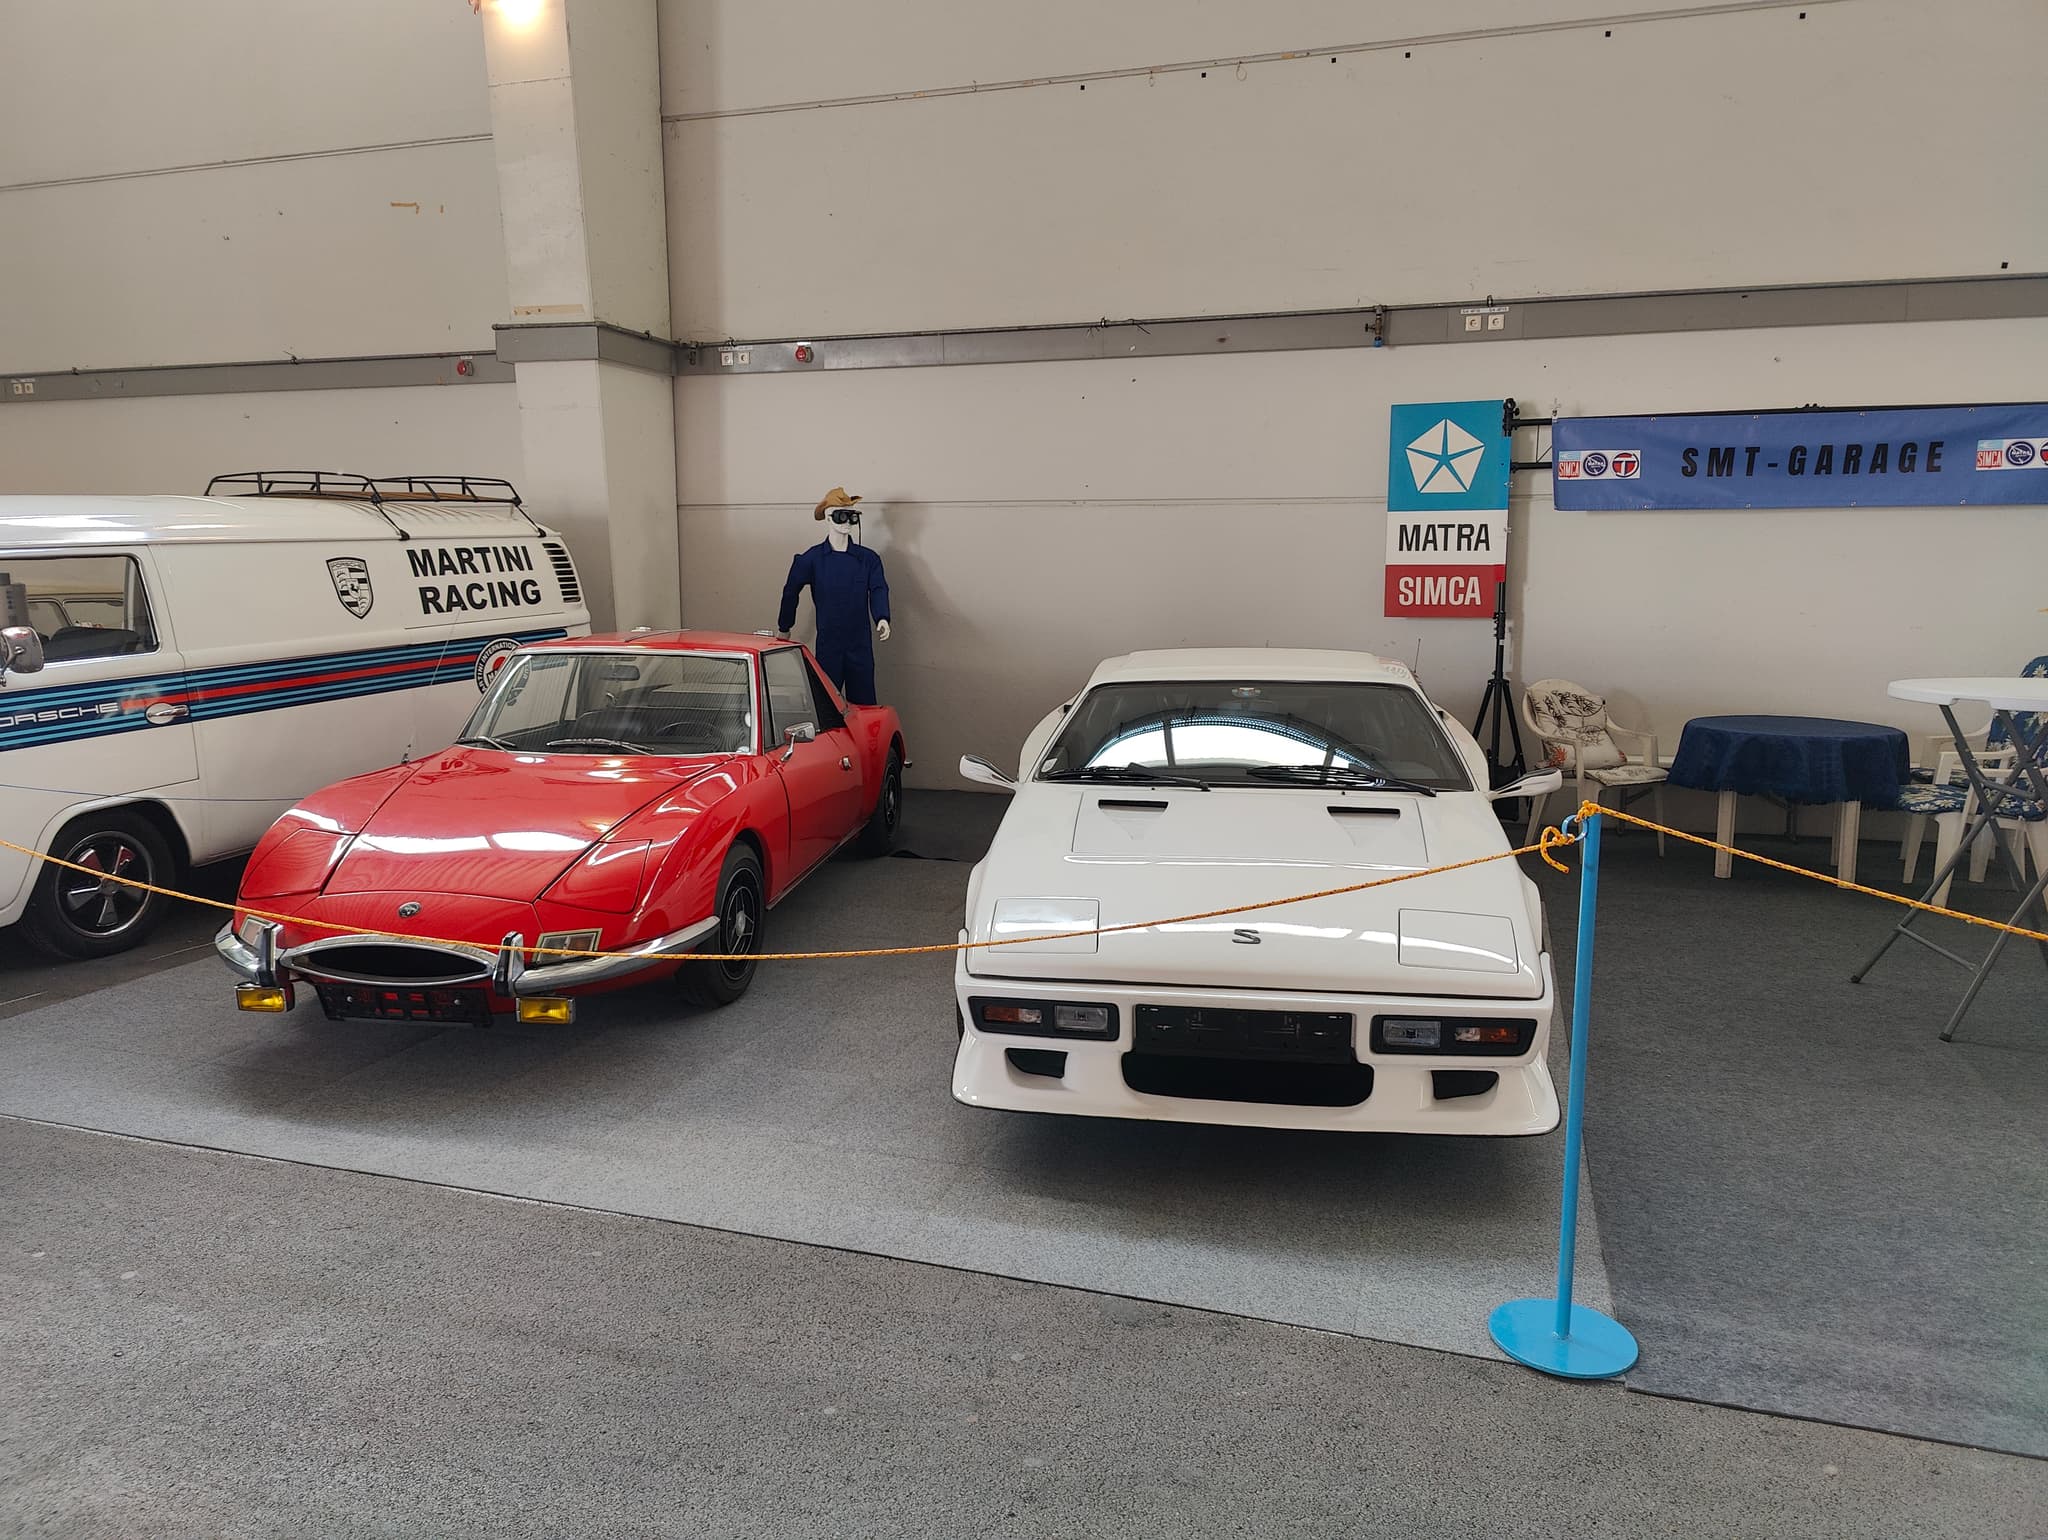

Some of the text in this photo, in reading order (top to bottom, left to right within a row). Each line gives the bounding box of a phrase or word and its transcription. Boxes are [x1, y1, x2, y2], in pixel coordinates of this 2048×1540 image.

[1559, 461, 1580, 476] SIMCA
[1681, 441, 1945, 477] SMT-GARAGE
[1976, 451, 2002, 466] SIMCA
[1398, 523, 1491, 552] MATRA
[406, 545, 534, 578] MARTINI
[418, 579, 542, 615] RACING
[1398, 576, 1482, 606] SIMCA
[478, 662, 489, 692] ARTINI
[0, 702, 119, 728] ORSCHE
[1231, 928, 1262, 945] S
